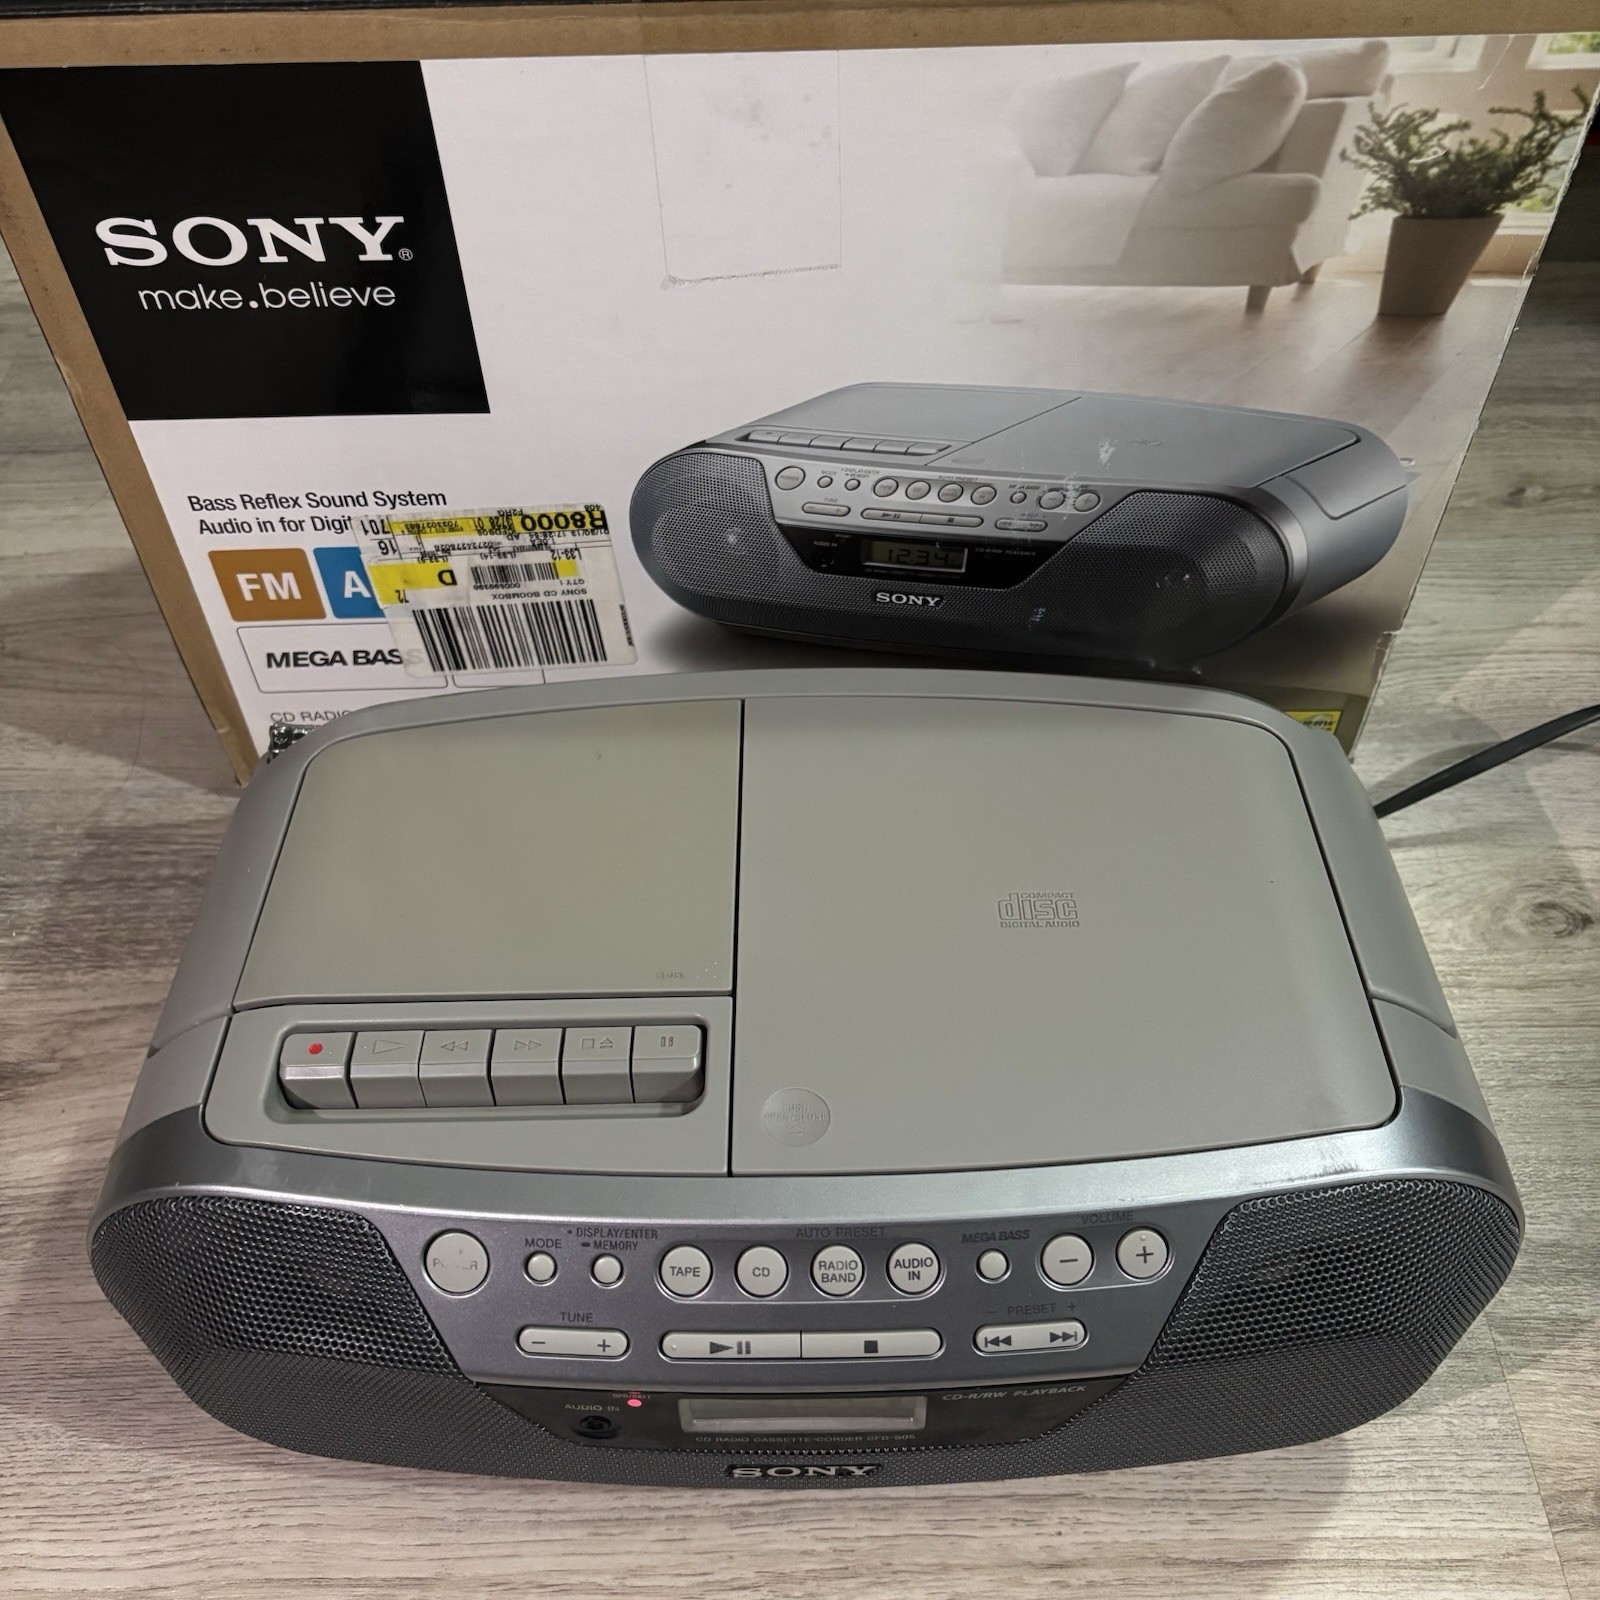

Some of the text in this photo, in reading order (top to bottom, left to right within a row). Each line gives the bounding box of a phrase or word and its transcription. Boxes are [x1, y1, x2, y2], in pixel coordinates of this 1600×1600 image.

[96, 216, 404, 267] SONY
[138, 281, 396, 310] make.believe
[188, 490, 447, 511] Bass Reflex Sound System
[199, 517, 253, 535] Audio
[256, 517, 273, 532] in
[279, 516, 305, 532] for
[360, 518, 390, 536] 701
[520, 510, 607, 532] R8000
[377, 539, 397, 556] 16
[437, 569, 458, 586] D
[236, 572, 302, 602] FM
[561, 588, 587, 596] SONY
[491, 591, 540, 600] BOOMBOX
[876, 592, 941, 607] SONY
[266, 650, 348, 669] MEGA
[270, 712, 296, 723] CD
[997, 892, 1078, 920] disc
[1000, 920, 1080, 928] DIGITAL AUDIO
[1080, 1211, 1134, 1225] VOLUME
[576, 1227, 658, 1240] DISPLAY/ENTER
[795, 1226, 885, 1238] AUTO PRESET
[961, 1229, 1030, 1244] MEGA BASS
[525, 1238, 562, 1249] MODE
[593, 1240, 639, 1251] MEMORY
[818, 1260, 858, 1272] RADIO
[893, 1257, 933, 1269] AUDIO
[669, 1266, 701, 1277] TAPE
[752, 1267, 770, 1278] CD
[821, 1272, 857, 1283] BAND
[907, 1270, 921, 1281] IN
[1007, 1303, 1056, 1316] PRESET
[560, 1312, 594, 1323] TUNE
[942, 1385, 1086, 1401] CD-R/RW PLAYBACK
[732, 1465, 877, 1478] SONY
